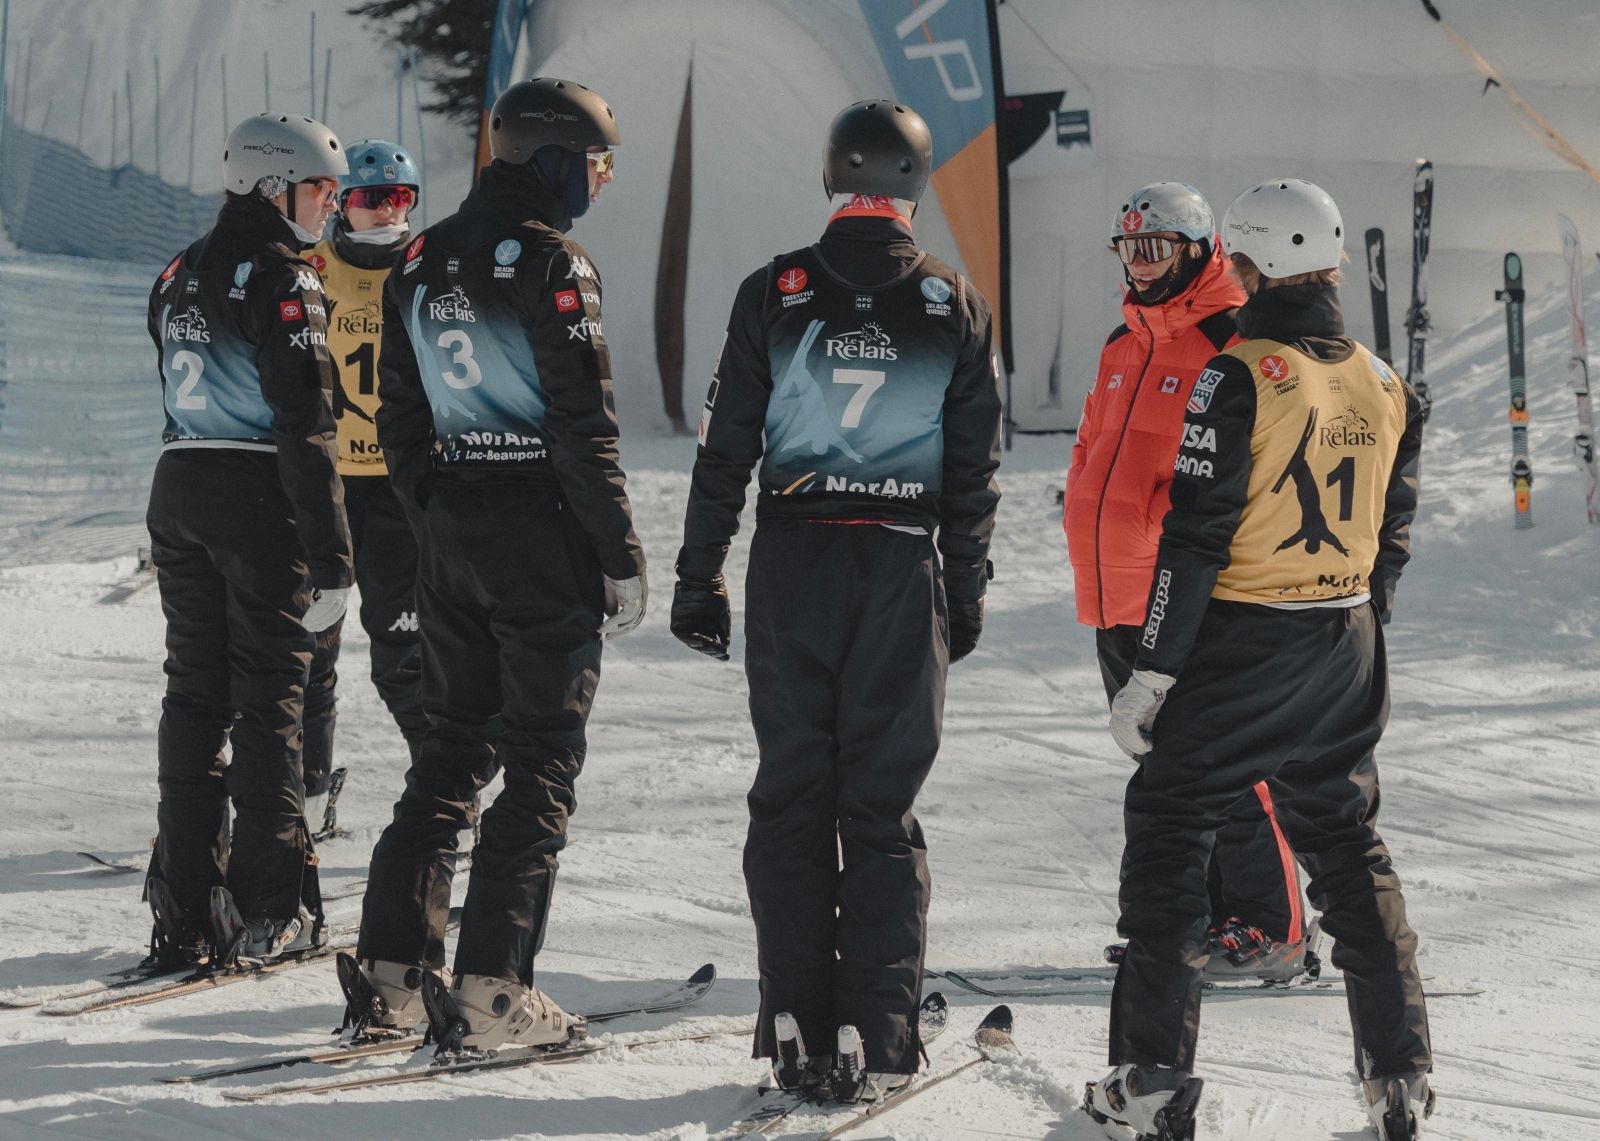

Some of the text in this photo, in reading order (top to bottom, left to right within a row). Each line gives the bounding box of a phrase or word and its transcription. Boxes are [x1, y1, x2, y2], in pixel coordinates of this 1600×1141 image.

[782, 290, 815, 302] FREESTYLE
[428, 302, 476, 323] Relais
[167, 322, 211, 344] Relais
[336, 317, 384, 336] Rela
[437, 329, 482, 390] 3
[825, 339, 898, 361] Relais
[345, 342, 374, 395] 1
[1200, 370, 1221, 386] US
[172, 350, 206, 410] 2
[1273, 374, 1300, 391] FREESTYLE
[832, 368, 886, 429] 7
[1320, 425, 1376, 449] Relais
[465, 449, 547, 462] Lac-Beauport
[825, 475, 925, 496] NorAm
[1326, 456, 1355, 522] 1
[1142, 569, 1172, 650] Kappa
